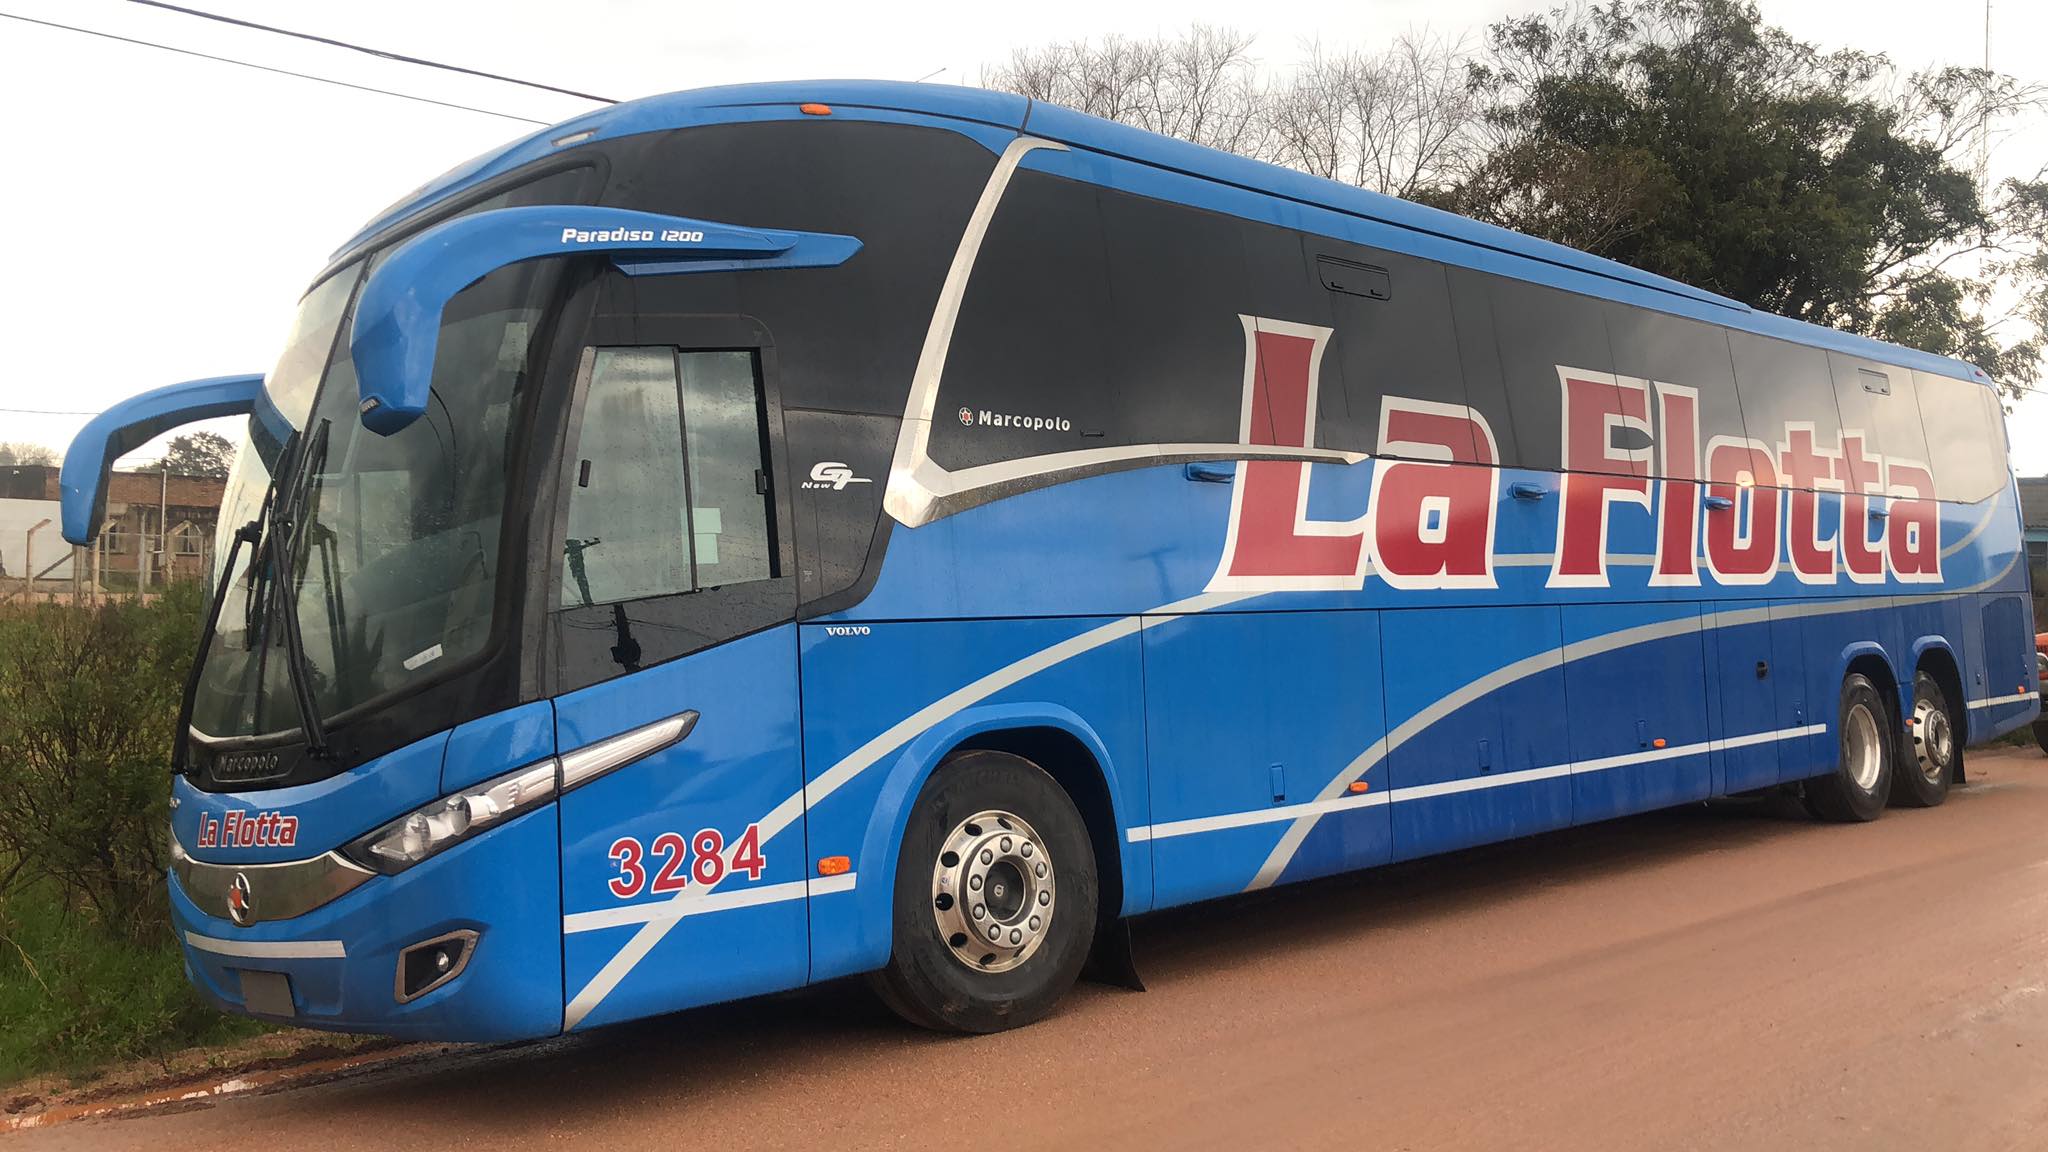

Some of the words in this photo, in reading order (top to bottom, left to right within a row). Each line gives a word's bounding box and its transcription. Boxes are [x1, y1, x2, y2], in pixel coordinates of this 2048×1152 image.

[561, 227, 653, 243] Paradiso
[661, 230, 703, 242] 1200
[978, 410, 1070, 431] Marcopolo
[1203, 313, 1499, 592] La
[1545, 364, 1944, 588] Flotta
[801, 481, 831, 489] New
[826, 626, 871, 636] VOLVO
[219, 752, 279, 773] Marcopolo
[198, 812, 219, 848] La
[221, 810, 298, 848] Flotta
[608, 823, 766, 899] 3284
